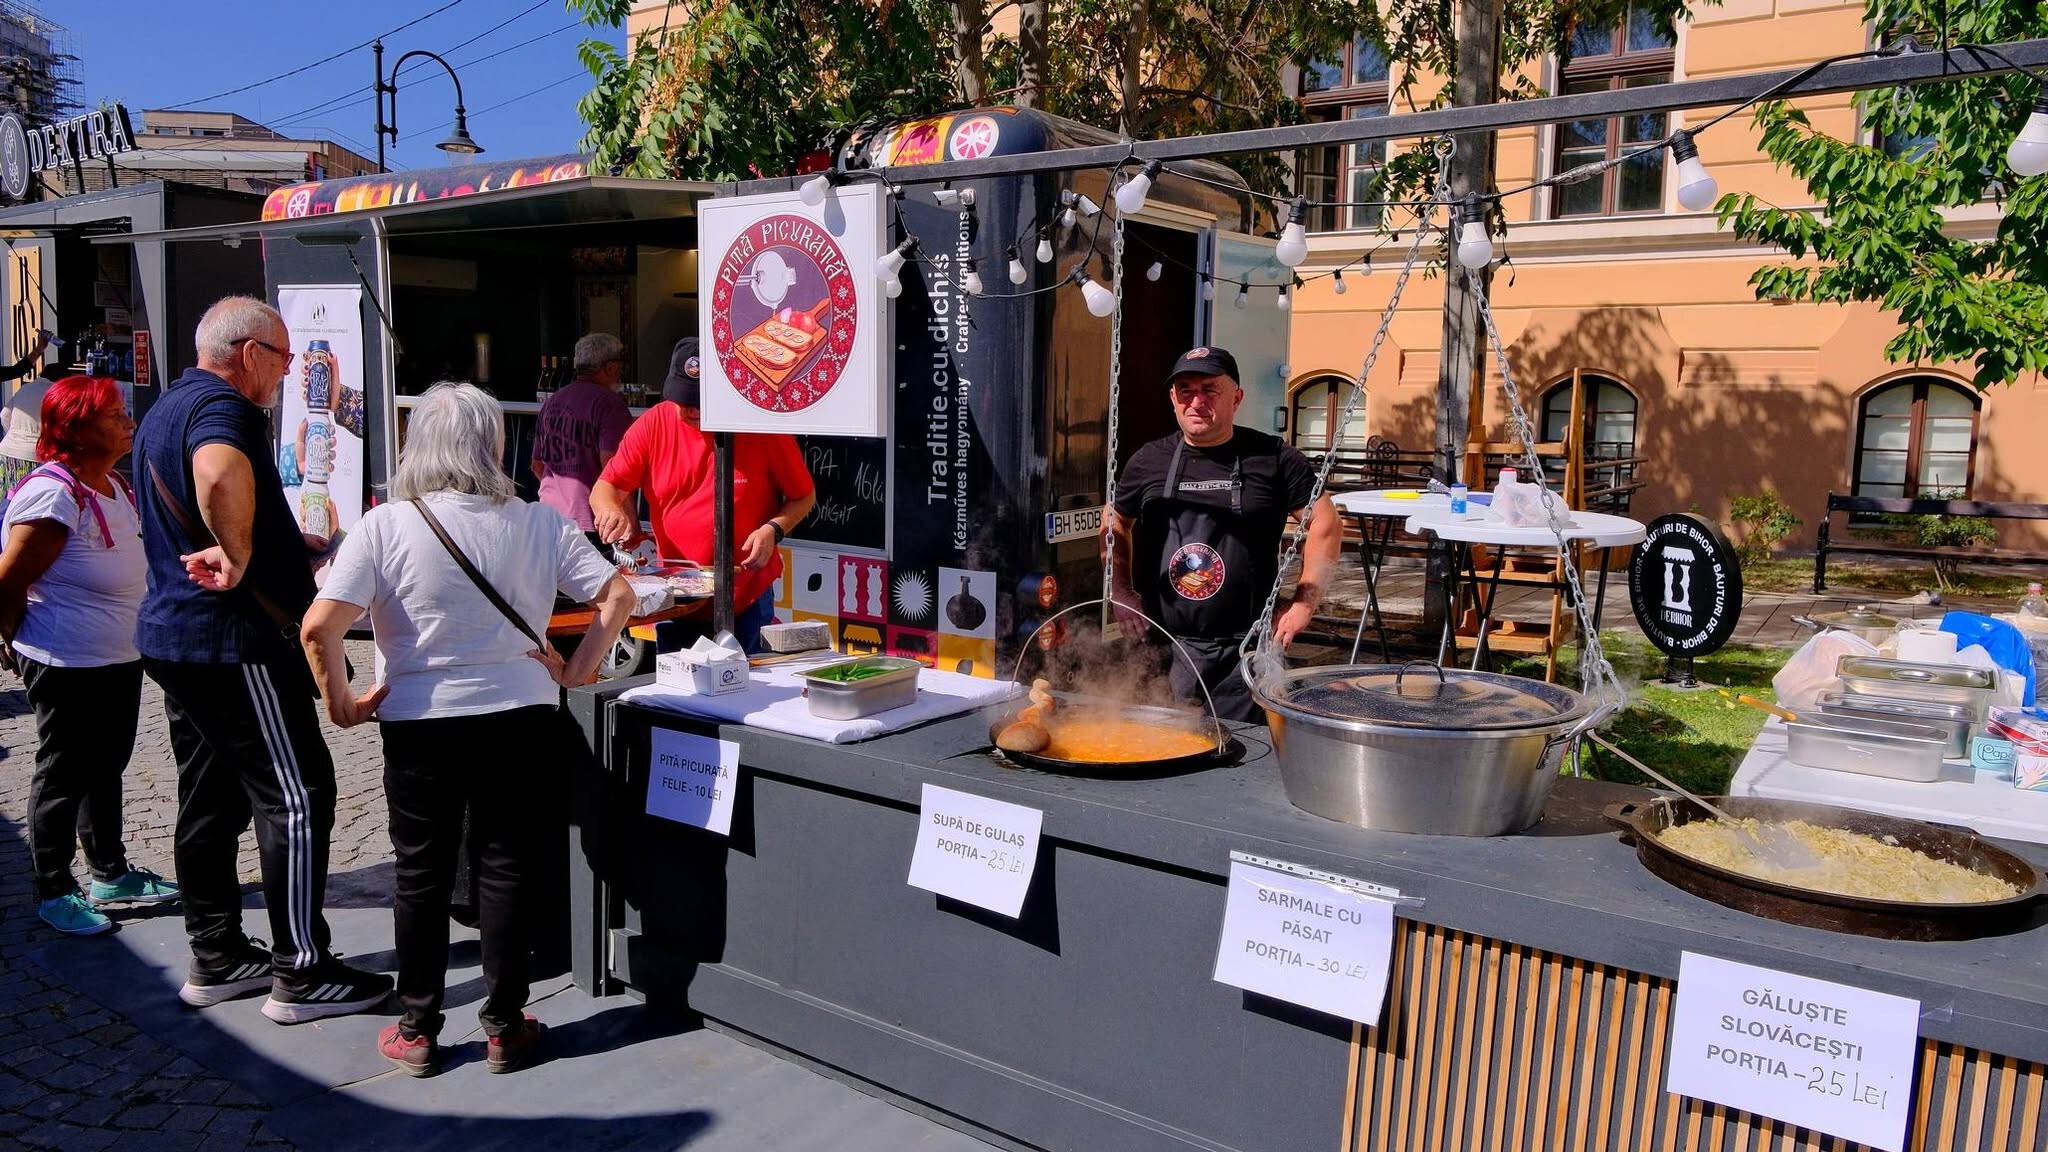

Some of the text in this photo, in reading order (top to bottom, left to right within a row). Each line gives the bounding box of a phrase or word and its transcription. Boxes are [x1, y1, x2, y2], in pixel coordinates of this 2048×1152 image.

[27, 103, 132, 172] DEXTRA
[722, 233, 755, 286] PITĂ
[954, 378, 971, 551] Kézműves hagyomány
[1055, 510, 1102, 535] BH 55DB
[1676, 523, 1688, 534] DE
[1689, 528, 1714, 556] BIHOR
[1682, 630, 1708, 649] BIHOR
[1705, 617, 1718, 634] DE
[660, 754, 728, 779] PITĂ PICURATĂ
[662, 777, 687, 793] FELIE
[694, 785, 706, 797] 10
[708, 788, 722, 801] LEI
[933, 813, 1025, 850] SUPĂ DE GULAȘ
[937, 838, 978, 859] PORȚIA
[988, 849, 1007, 870] 25
[1258, 888, 1362, 925] SARMALE CU
[1282, 920, 1333, 944] PĂSAT
[1246, 940, 1302, 967] PORȚIA
[1317, 958, 1340, 974] 30
[1742, 988, 1848, 1026] GĂLUȘTE
[1720, 1015, 1863, 1062] SLOVĂCEȘTI
[1706, 1044, 1790, 1078] PORȚIA
[1807, 1066, 1847, 1097] 25
